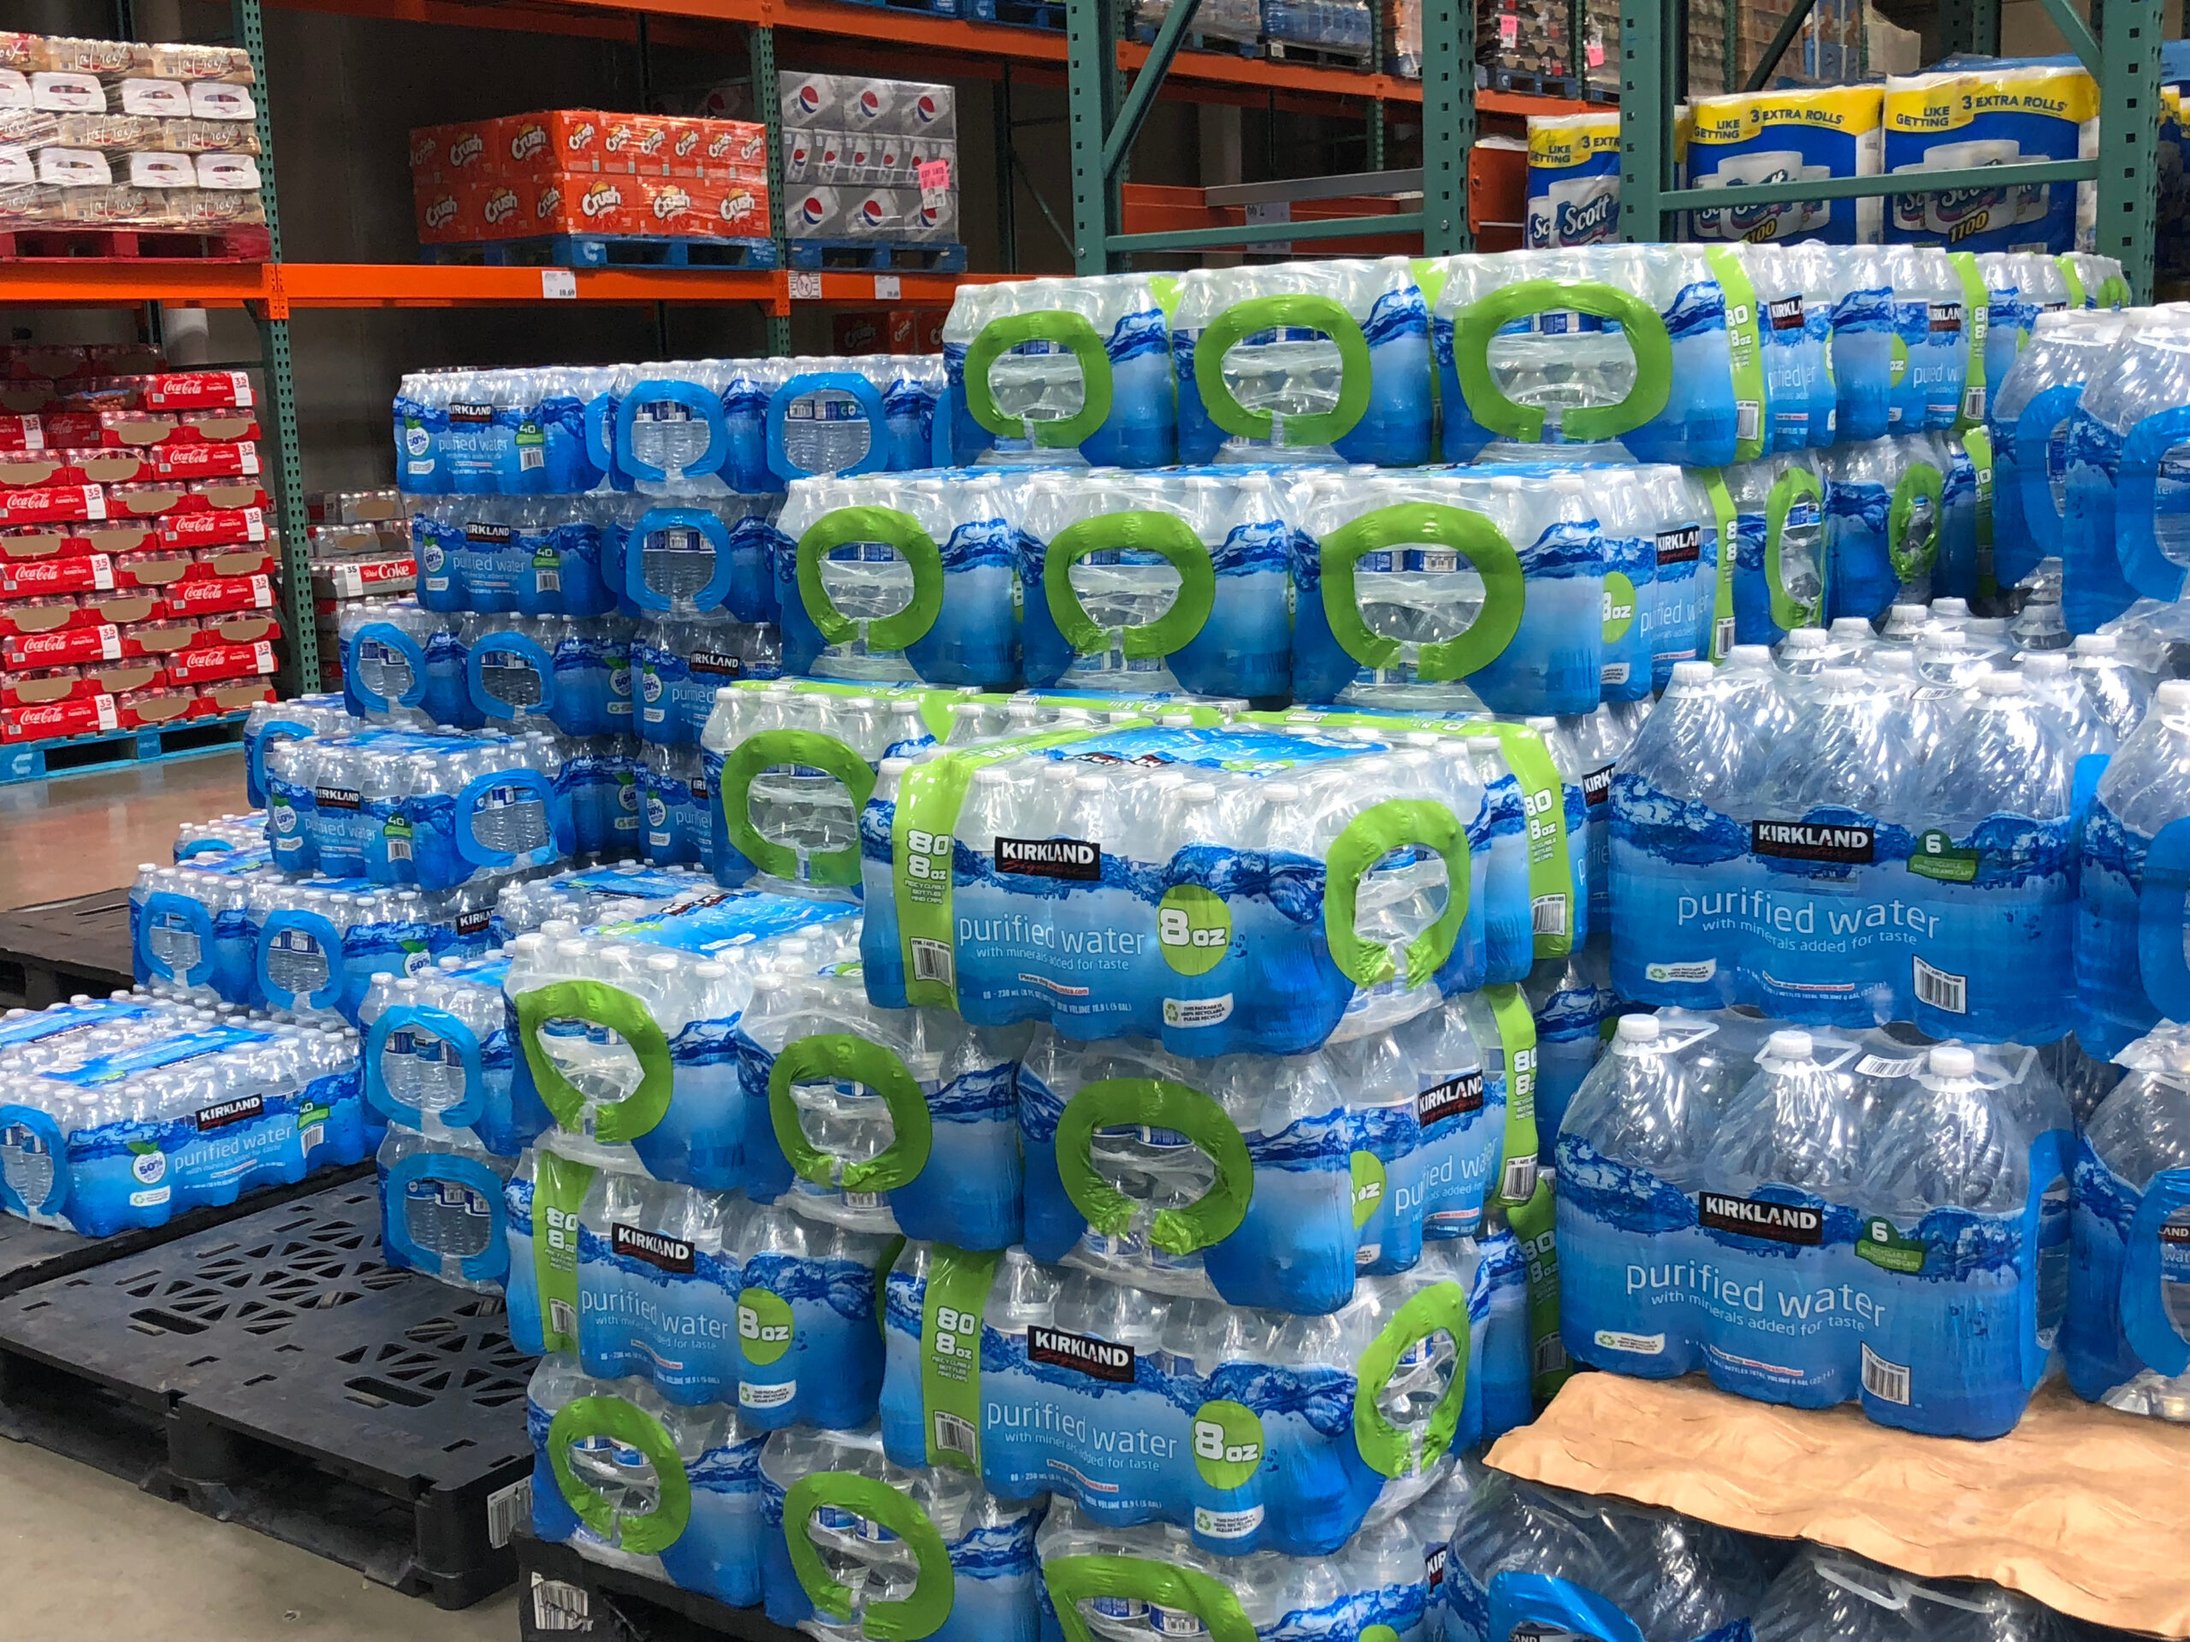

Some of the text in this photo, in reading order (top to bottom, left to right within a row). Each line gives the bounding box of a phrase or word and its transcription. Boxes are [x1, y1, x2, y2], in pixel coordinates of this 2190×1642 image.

[1750, 109, 1760, 123] 3
[1763, 109, 1802, 121] EXTRA
[1923, 106, 1950, 116] LIKE
[1962, 95, 1972, 110] 3
[1976, 95, 2019, 108] EXTRA
[1694, 127, 1740, 139] GETTING
[1716, 119, 1740, 130] LIKE
[1896, 113, 1949, 126] GETTING
[449, 133, 483, 167] Crush
[512, 123, 547, 161] Crush
[568, 122, 595, 151] Crush
[605, 124, 631, 153] Crush
[641, 128, 665, 155] Crush
[675, 130, 699, 157] Crush
[708, 132, 733, 159] Crush
[1548, 145, 1571, 154] LIKE
[1582, 136, 1620, 149] 3 EXTR
[425, 196, 458, 229] Crush
[484, 190, 518, 224] Crush
[537, 187, 561, 219] Crush
[582, 186, 622, 217] Crush
[653, 189, 691, 220] Crush
[720, 192, 756, 222] Crush
[1563, 193, 1610, 236] Scott
[1949, 211, 1989, 243] 1100
[1890, 360, 1904, 371] oz
[519, 424, 536, 434] 40
[536, 548, 553, 557] 40
[346, 565, 358, 574] 35
[378, 563, 410, 579] Coke
[387, 816, 404, 826] 40
[1529, 818, 1557, 841] 8oz
[907, 829, 950, 856] 80
[1758, 824, 1869, 849] KIRKLAND
[1925, 834, 1941, 854] 6
[1001, 841, 1095, 865] KIRKLAND
[1677, 886, 1940, 939] purified water
[959, 913, 1055, 949] purified
[1060, 927, 1145, 956] water
[1702, 917, 1918, 953] with minerals added for taste
[976, 946, 1003, 958] with
[1006, 947, 1048, 963] minerals
[1077, 958, 1093, 971] for
[1098, 959, 1129, 971] taste
[1419, 1074, 1483, 1114] KIRKLAND
[199, 1096, 261, 1122] KIRKLAND
[174, 1126, 293, 1174] purified water
[1351, 1181, 1382, 1205] oz
[546, 1206, 578, 1232] 80
[1706, 1196, 1817, 1230] KIRKLAND
[618, 1227, 690, 1261] KIRKLAND
[1871, 1221, 1888, 1243] 6
[1626, 1258, 1886, 1328] purified water
[581, 1288, 729, 1340] purified water
[936, 1306, 976, 1335] 80
[1650, 1289, 1866, 1337] with minerals added for taste
[595, 1314, 619, 1326] with
[691, 1338, 717, 1350] taste
[1035, 1331, 1129, 1368] KIRKLAND
[987, 1402, 1086, 1444] purified
[1092, 1424, 1178, 1459] water
[1004, 1431, 1032, 1443] with
[1034, 1434, 1078, 1455] minerals
[1107, 1456, 1125, 1469] for
[1129, 1458, 1160, 1472] taste
